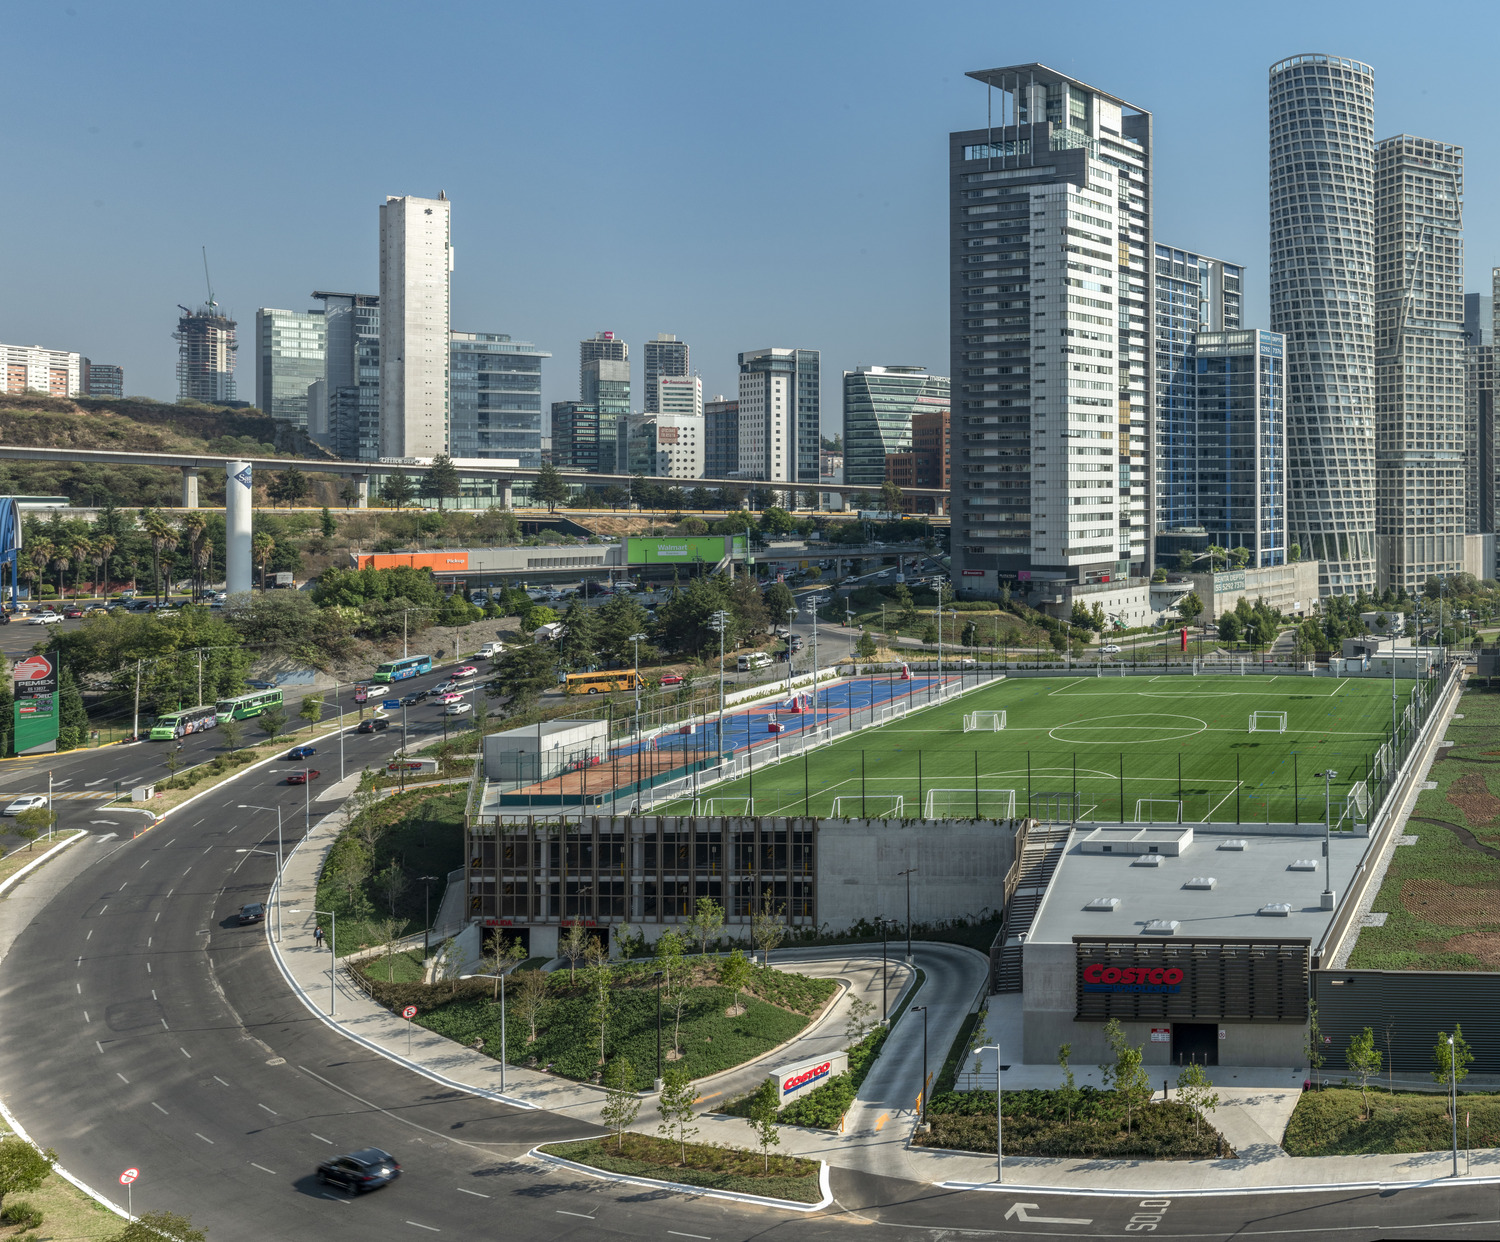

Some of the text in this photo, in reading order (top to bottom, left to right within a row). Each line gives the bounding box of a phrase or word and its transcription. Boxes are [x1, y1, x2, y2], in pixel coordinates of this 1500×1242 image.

[1215, 575, 1229, 583] RENTA
[1215, 584, 1222, 592] 55
[1222, 583, 1233, 591] 5292
[18, 679, 54, 687] PEMEX
[389, 762, 422, 770] CTCO
[1112, 985, 1181, 994] WHOLESALE
[783, 1062, 830, 1090] COSTCO
[1125, 1199, 1171, 1231] SOLO
